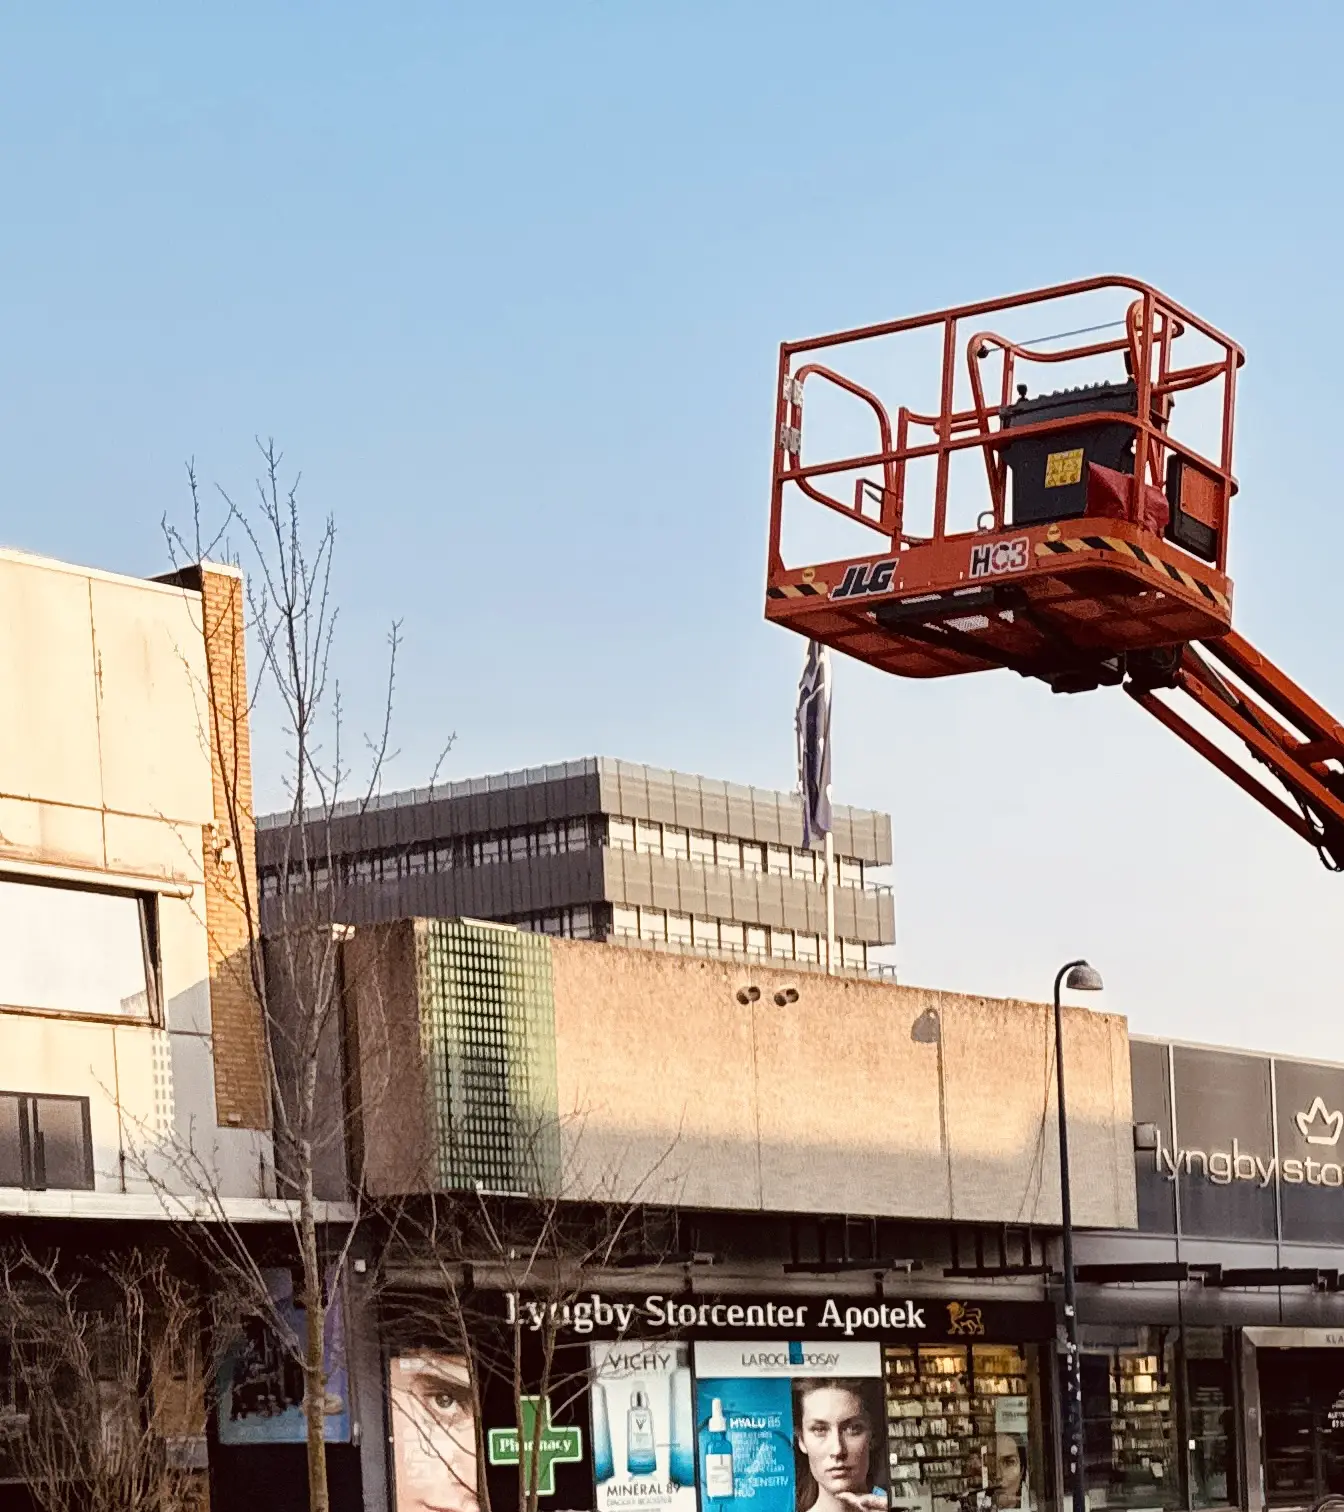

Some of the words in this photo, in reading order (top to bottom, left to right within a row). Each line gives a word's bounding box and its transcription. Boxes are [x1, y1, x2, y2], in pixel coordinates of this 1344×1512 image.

[972, 538, 1028, 577] HC3
[833, 561, 898, 599] JLG
[1156, 1130, 1275, 1187] lyngby
[506, 1293, 635, 1333] Lyngby
[646, 1295, 808, 1327] Storcenter
[818, 1298, 926, 1335] Apotek
[609, 1354, 670, 1369] VICHY
[729, 1417, 766, 1429] HYALU
